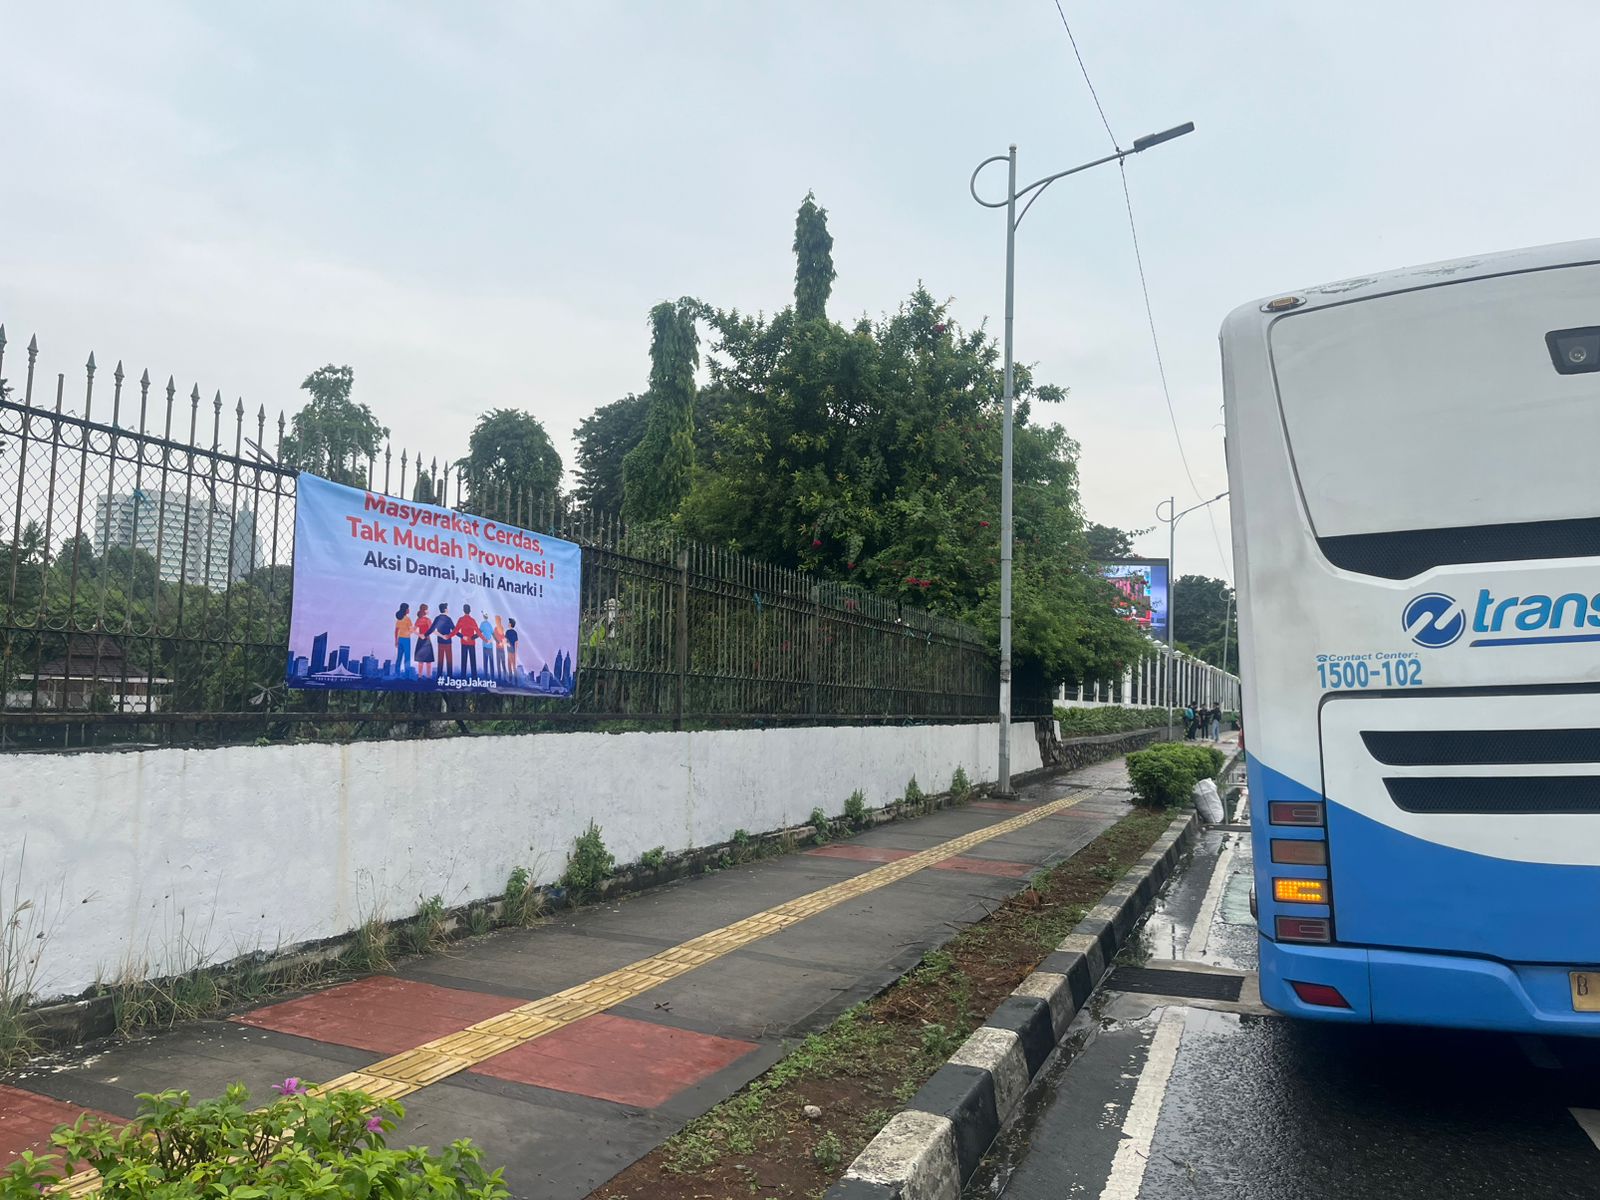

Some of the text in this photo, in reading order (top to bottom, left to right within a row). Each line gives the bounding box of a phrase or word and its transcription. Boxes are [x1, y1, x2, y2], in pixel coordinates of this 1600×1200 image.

[364, 492, 544, 556] Masyarakat Cerdas,
[346, 515, 388, 544] Tak
[393, 526, 463, 559] Mudah
[467, 543, 546, 577] Provokasi
[363, 550, 401, 572] Aksi
[406, 557, 459, 584] Damai,
[462, 568, 494, 589] Jauhi
[497, 576, 537, 597] Anarki
[1317, 659, 1423, 689] 1500-102
[1328, 652, 1419, 662] Contact Center:
[437, 676, 497, 689] #JagaJakarta
